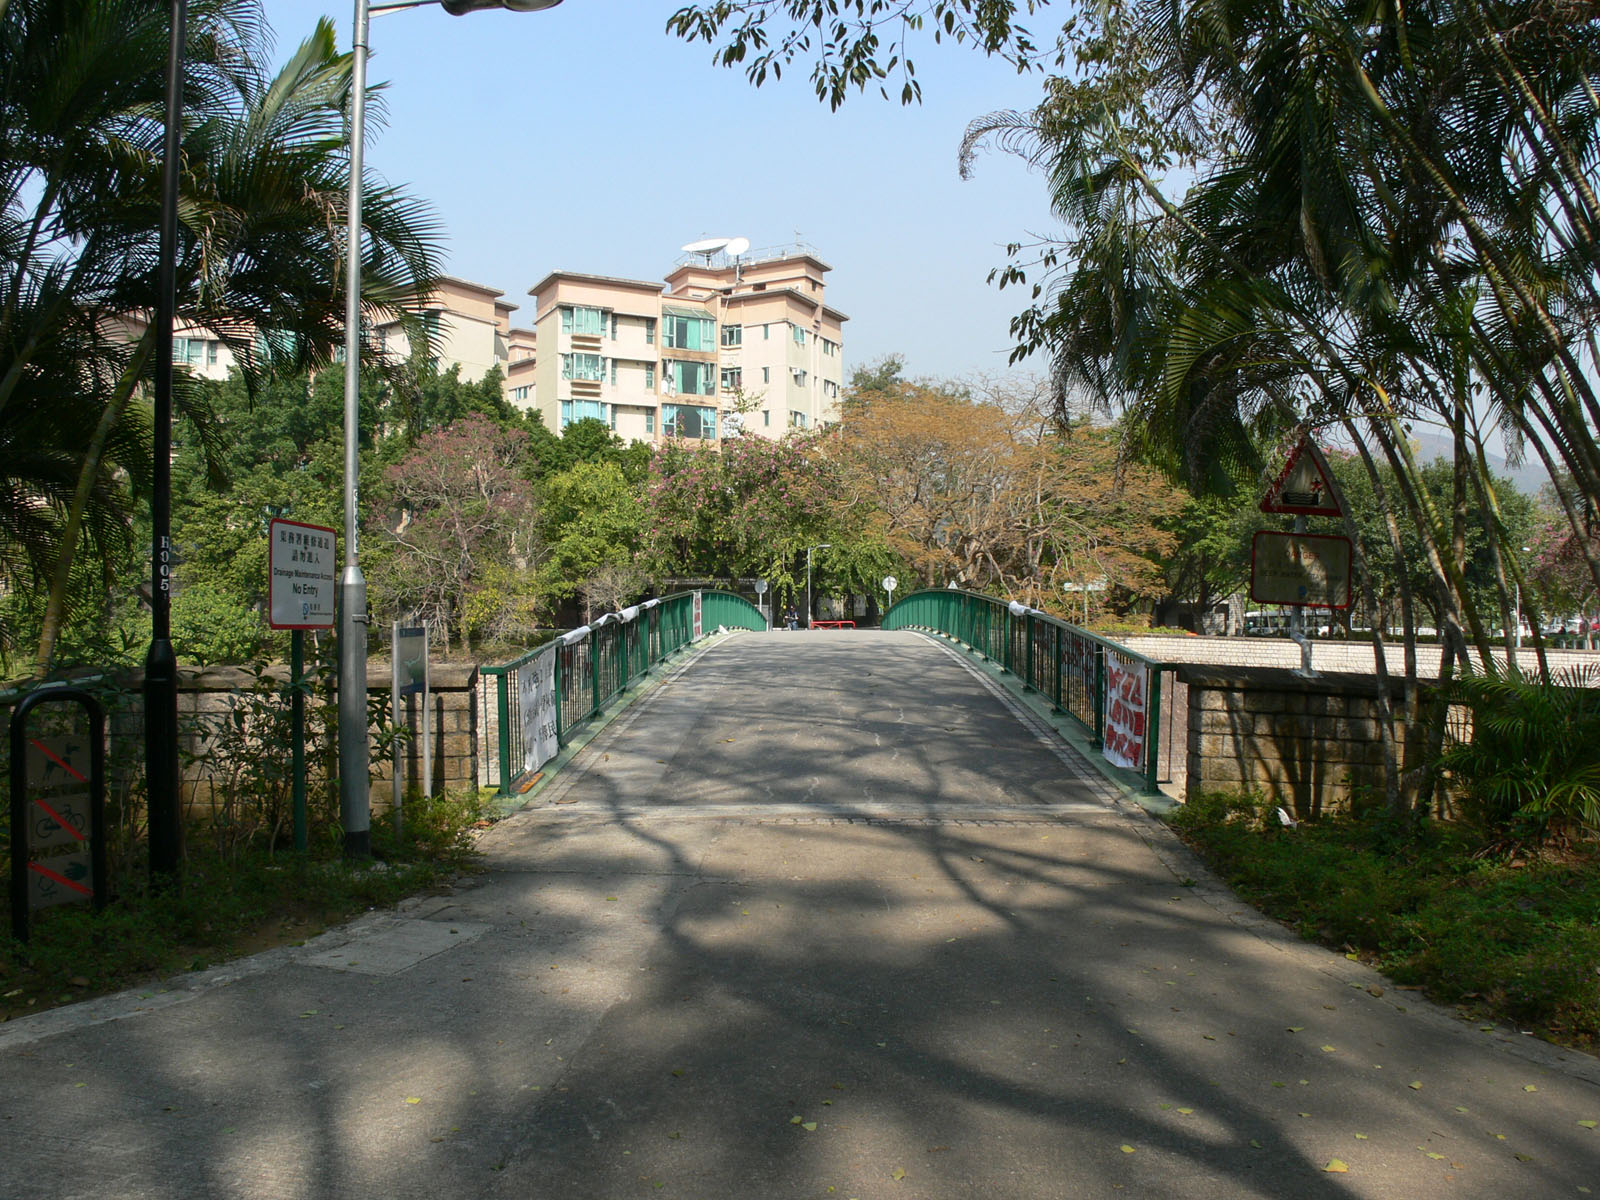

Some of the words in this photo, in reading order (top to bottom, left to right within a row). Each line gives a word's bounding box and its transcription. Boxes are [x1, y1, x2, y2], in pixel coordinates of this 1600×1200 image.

[274, 568, 294, 579] Drainage
[295, 570, 320, 579] Maintenance
[292, 583, 301, 594] No
[303, 583, 318, 597] Entry
